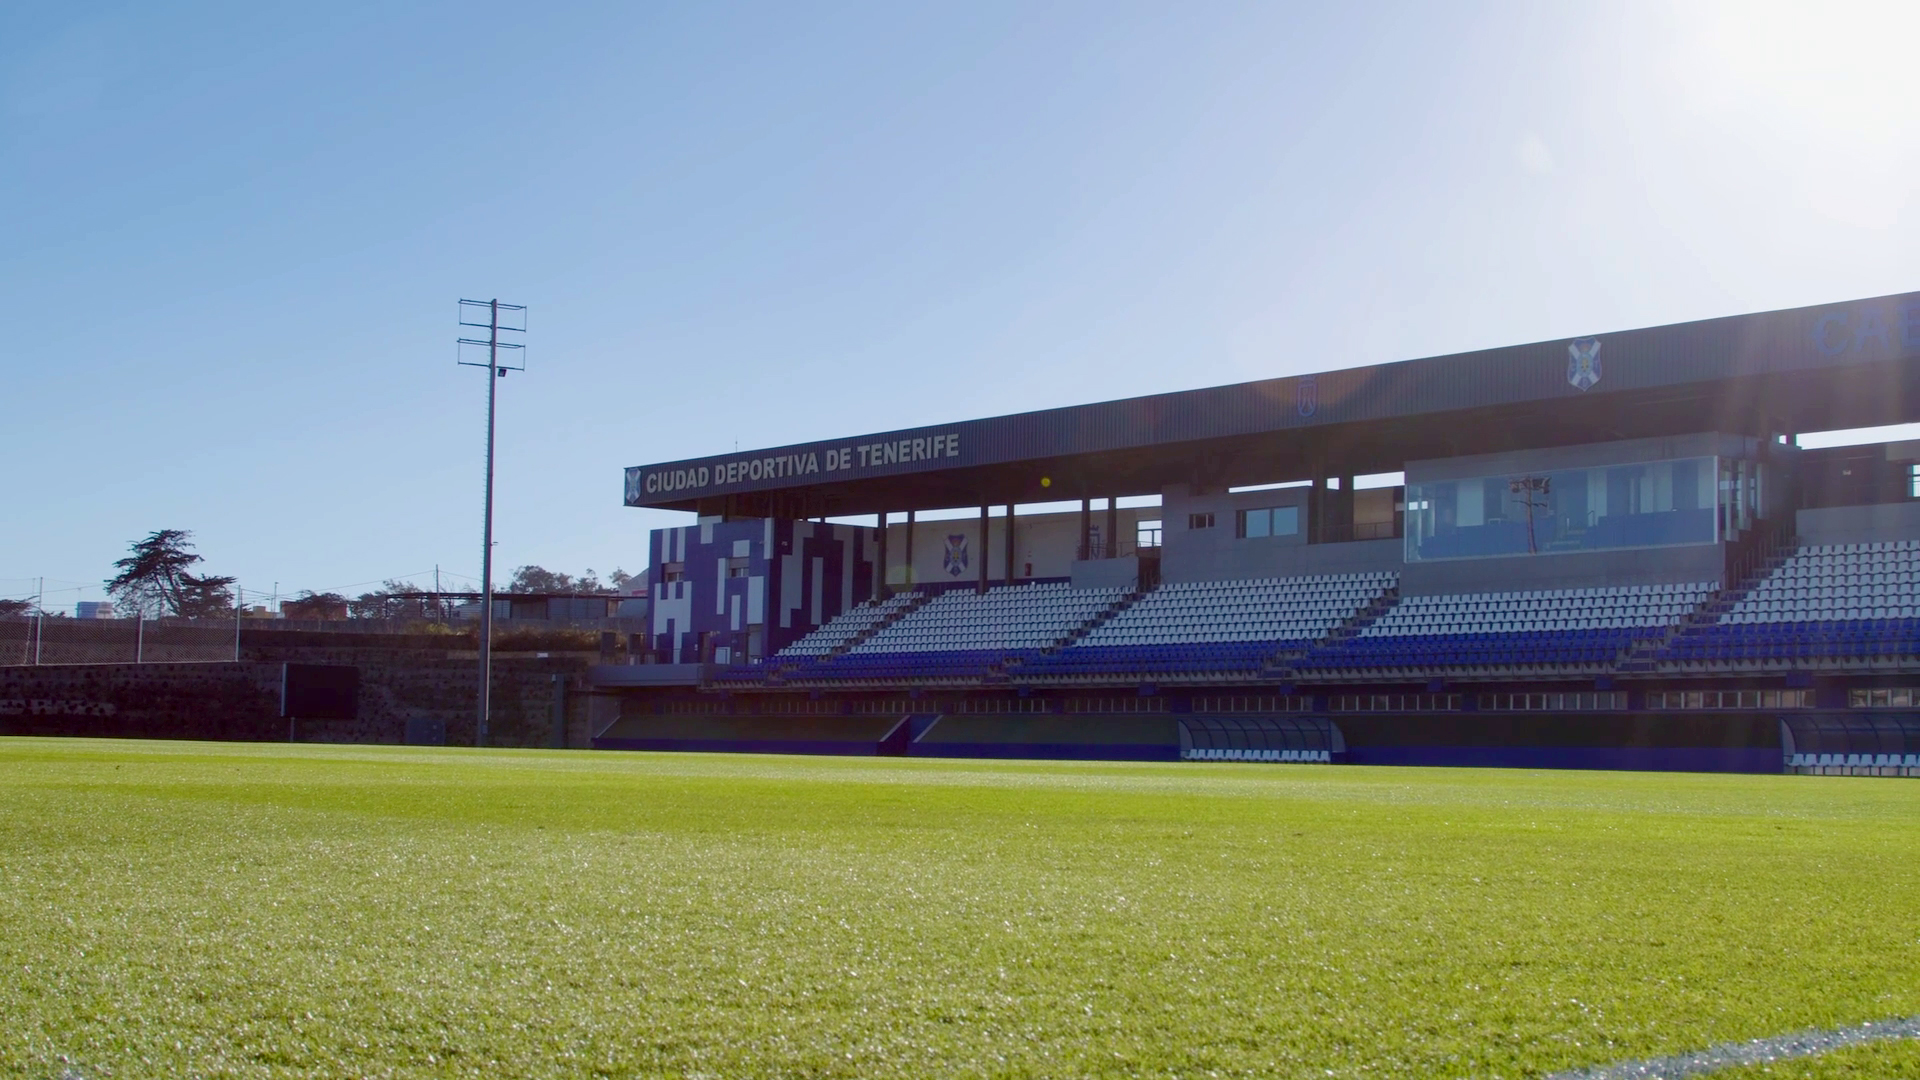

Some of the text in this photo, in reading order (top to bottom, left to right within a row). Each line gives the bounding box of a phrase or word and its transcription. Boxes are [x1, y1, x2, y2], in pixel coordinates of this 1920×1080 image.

[646, 433, 960, 493] CIUDAD DEPORTIVA DE TENERIFE
